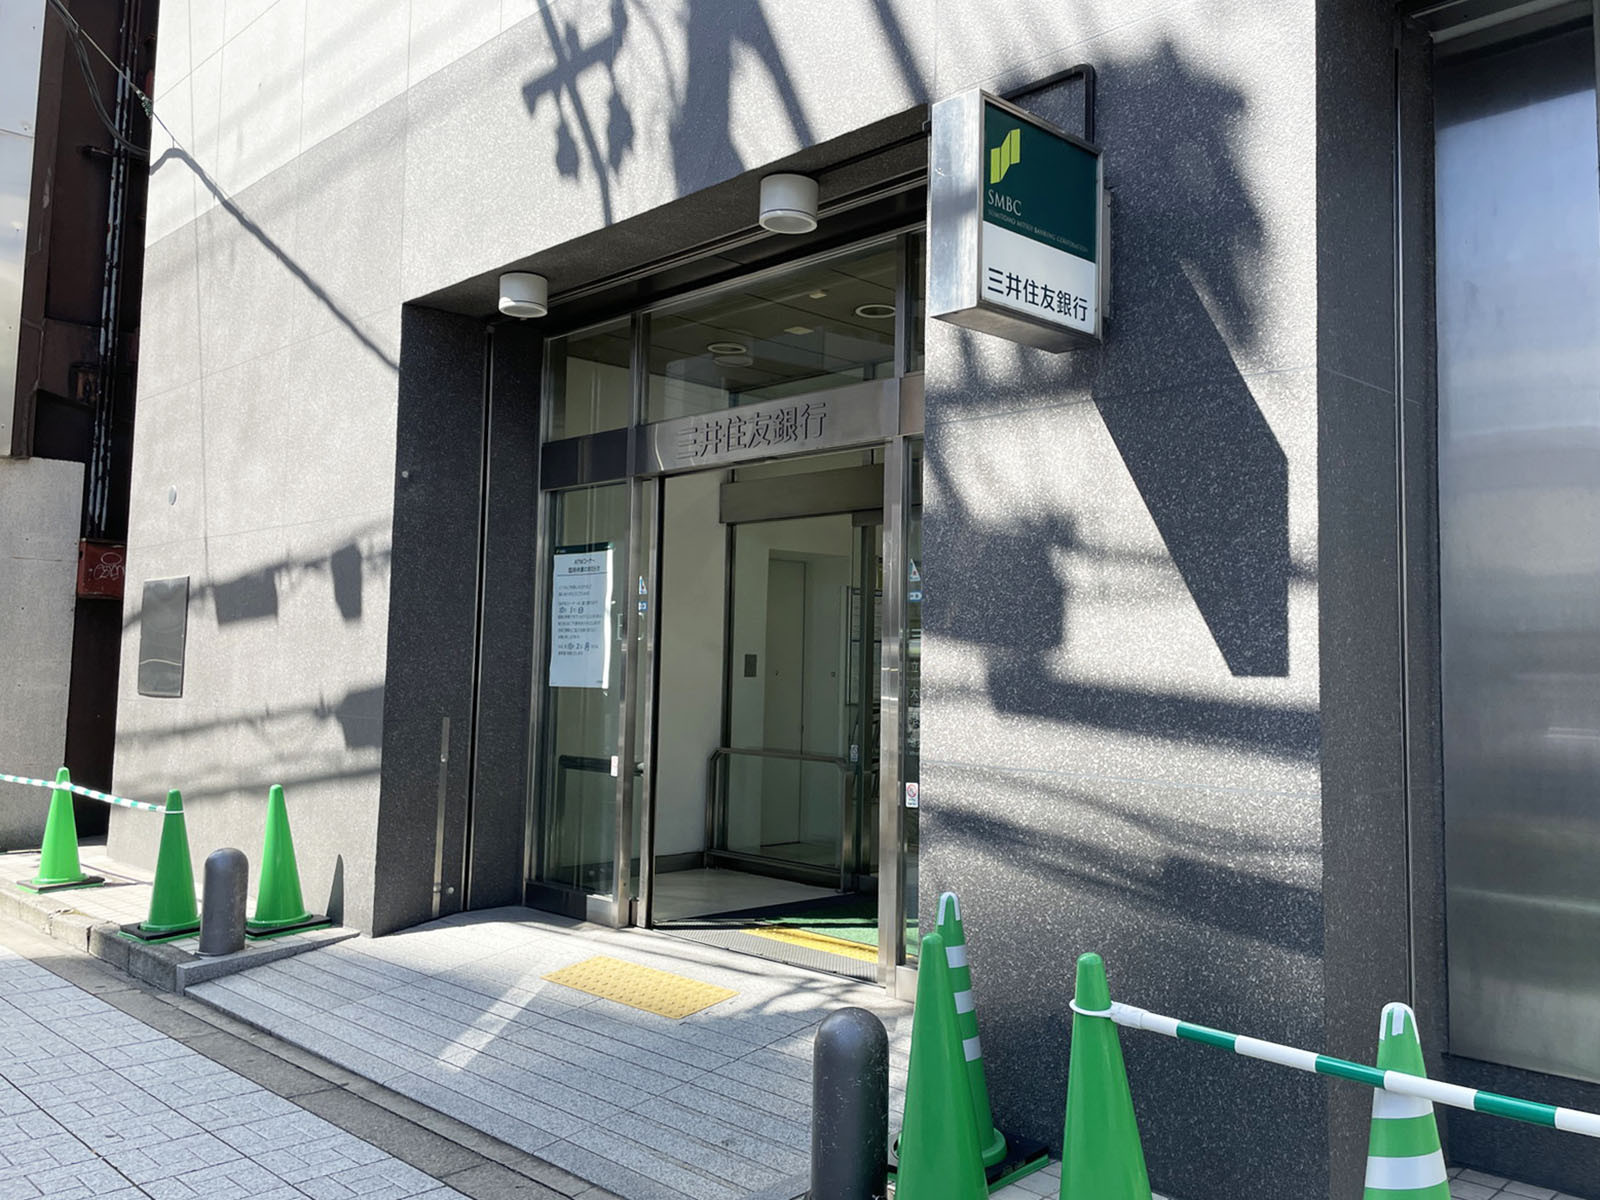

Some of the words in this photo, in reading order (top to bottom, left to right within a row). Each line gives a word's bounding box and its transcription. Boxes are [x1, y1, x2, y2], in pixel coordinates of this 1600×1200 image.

[987, 189, 1022, 217] SMBC
[988, 267, 1088, 322] 三井住友銀行
[676, 402, 827, 460] 三井住友銀行
